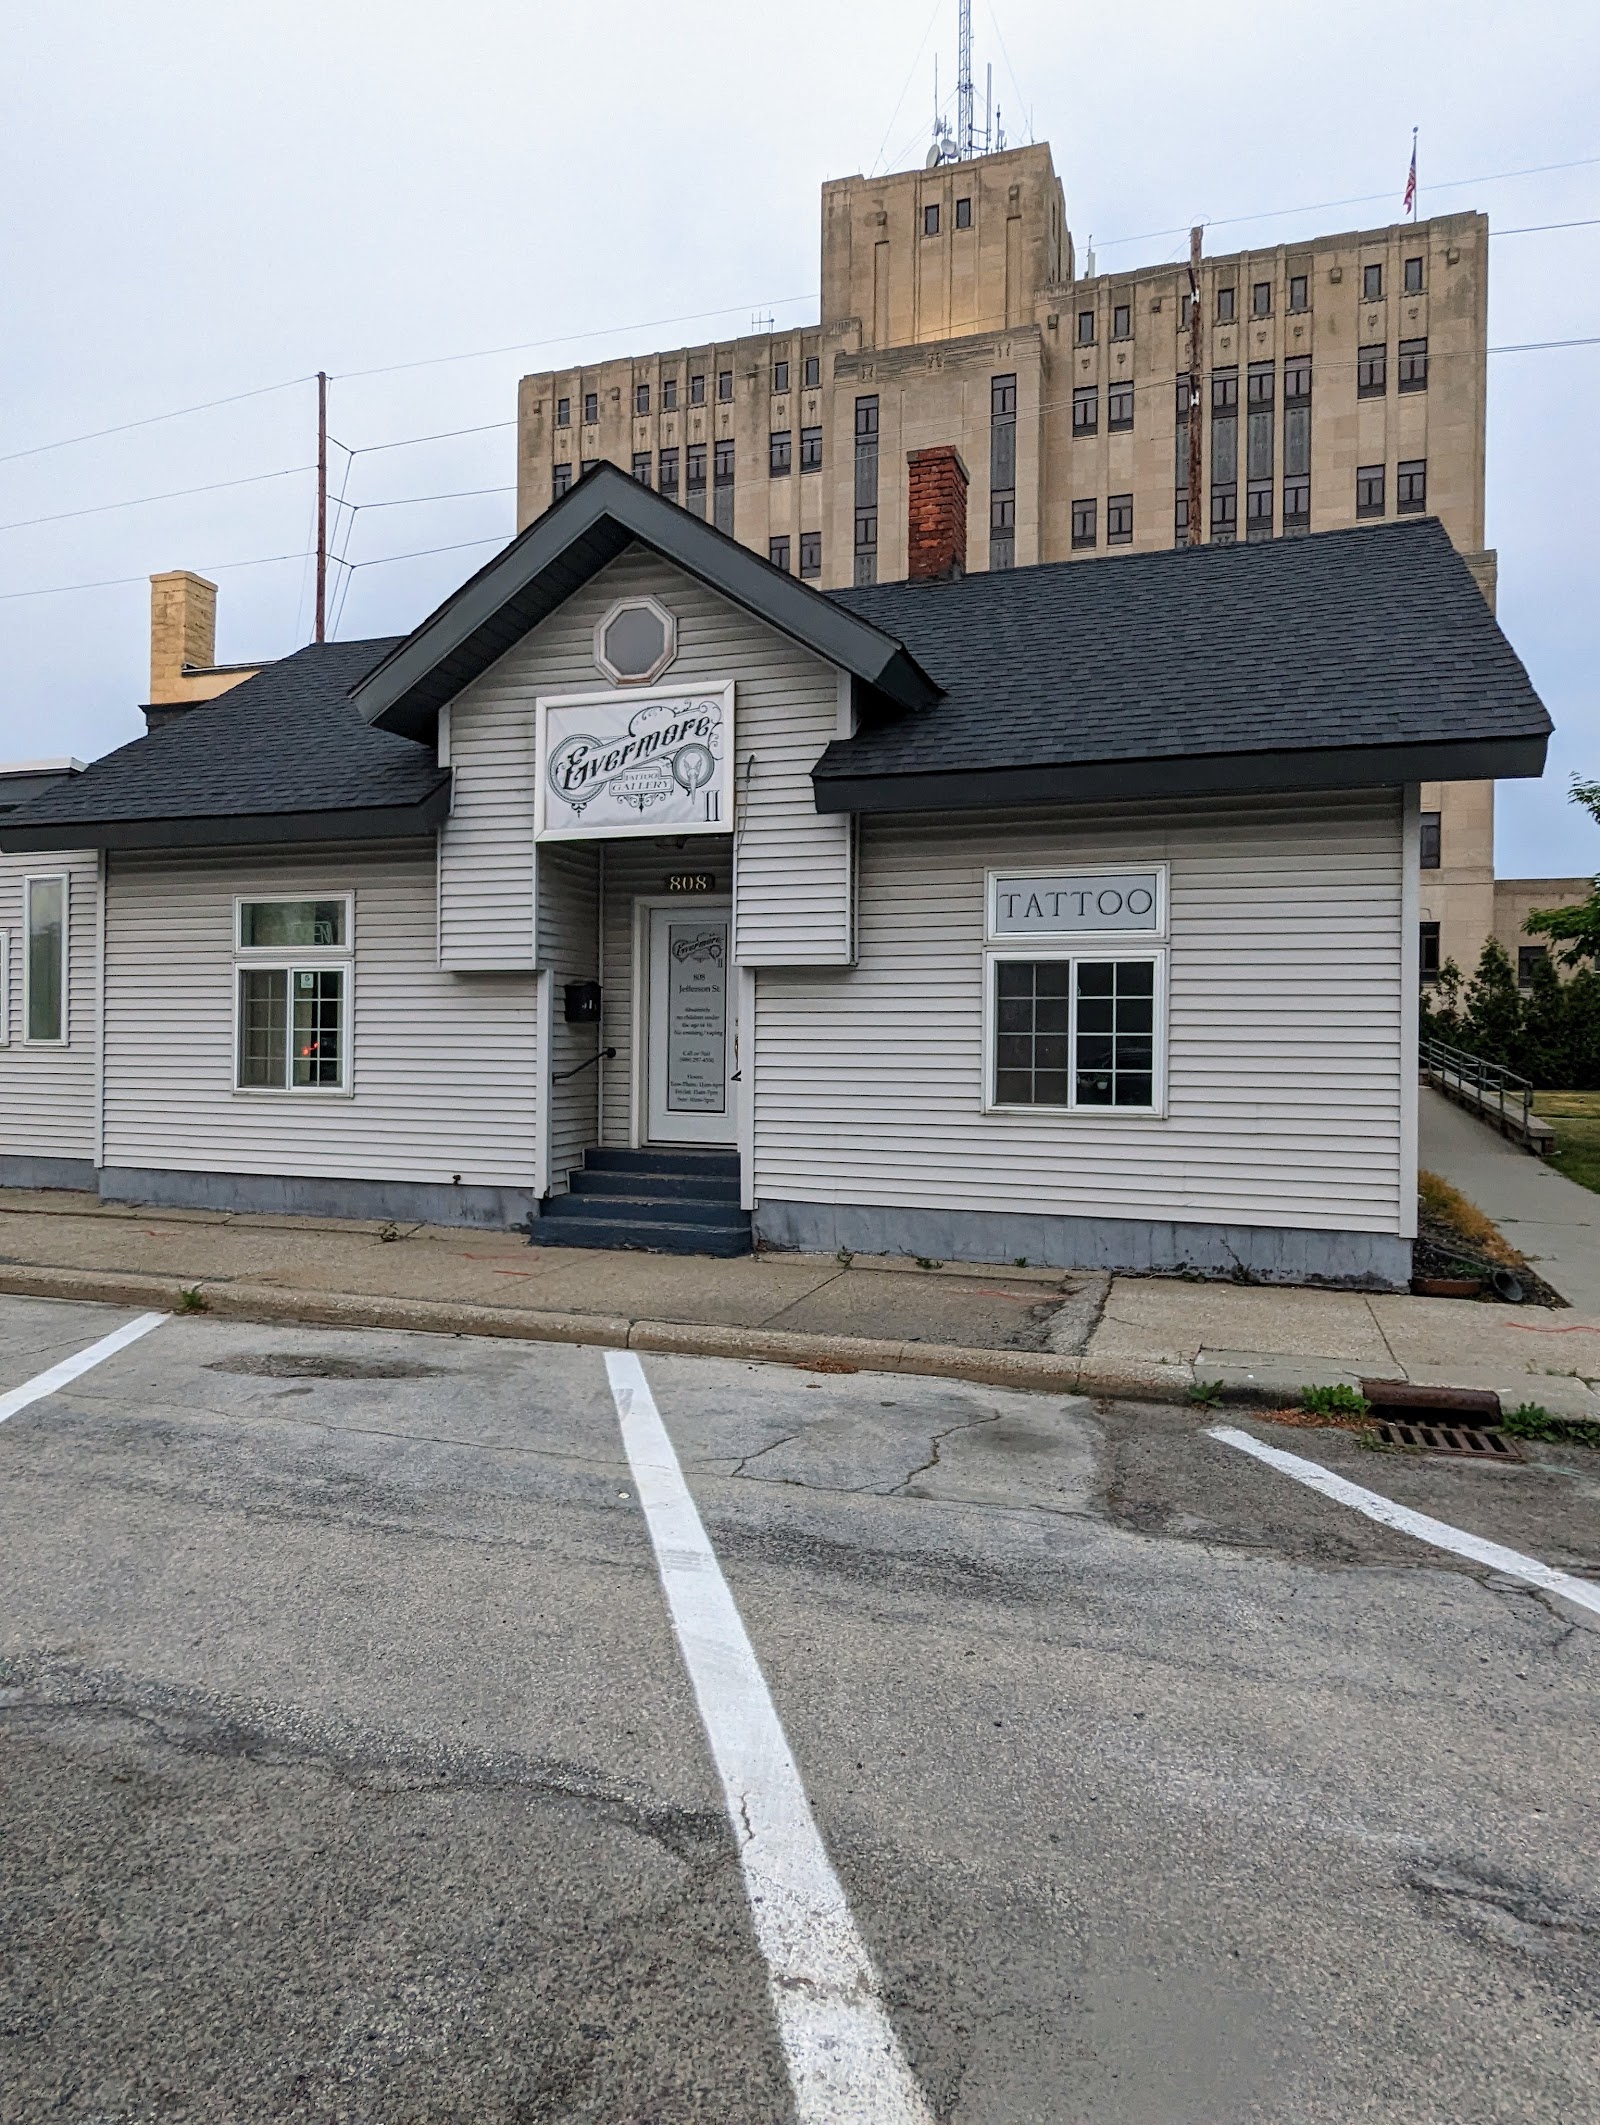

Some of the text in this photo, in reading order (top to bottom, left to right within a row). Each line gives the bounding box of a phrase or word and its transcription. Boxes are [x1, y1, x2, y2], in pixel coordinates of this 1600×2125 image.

[556, 716, 711, 791] Evermore
[624, 773, 659, 781] TATTOO
[612, 781, 669, 791] GALLERY
[703, 789, 721, 822] II
[669, 875, 707, 891] 808
[999, 888, 1153, 919] TATTOO
[679, 985, 711, 994] Jefferson
